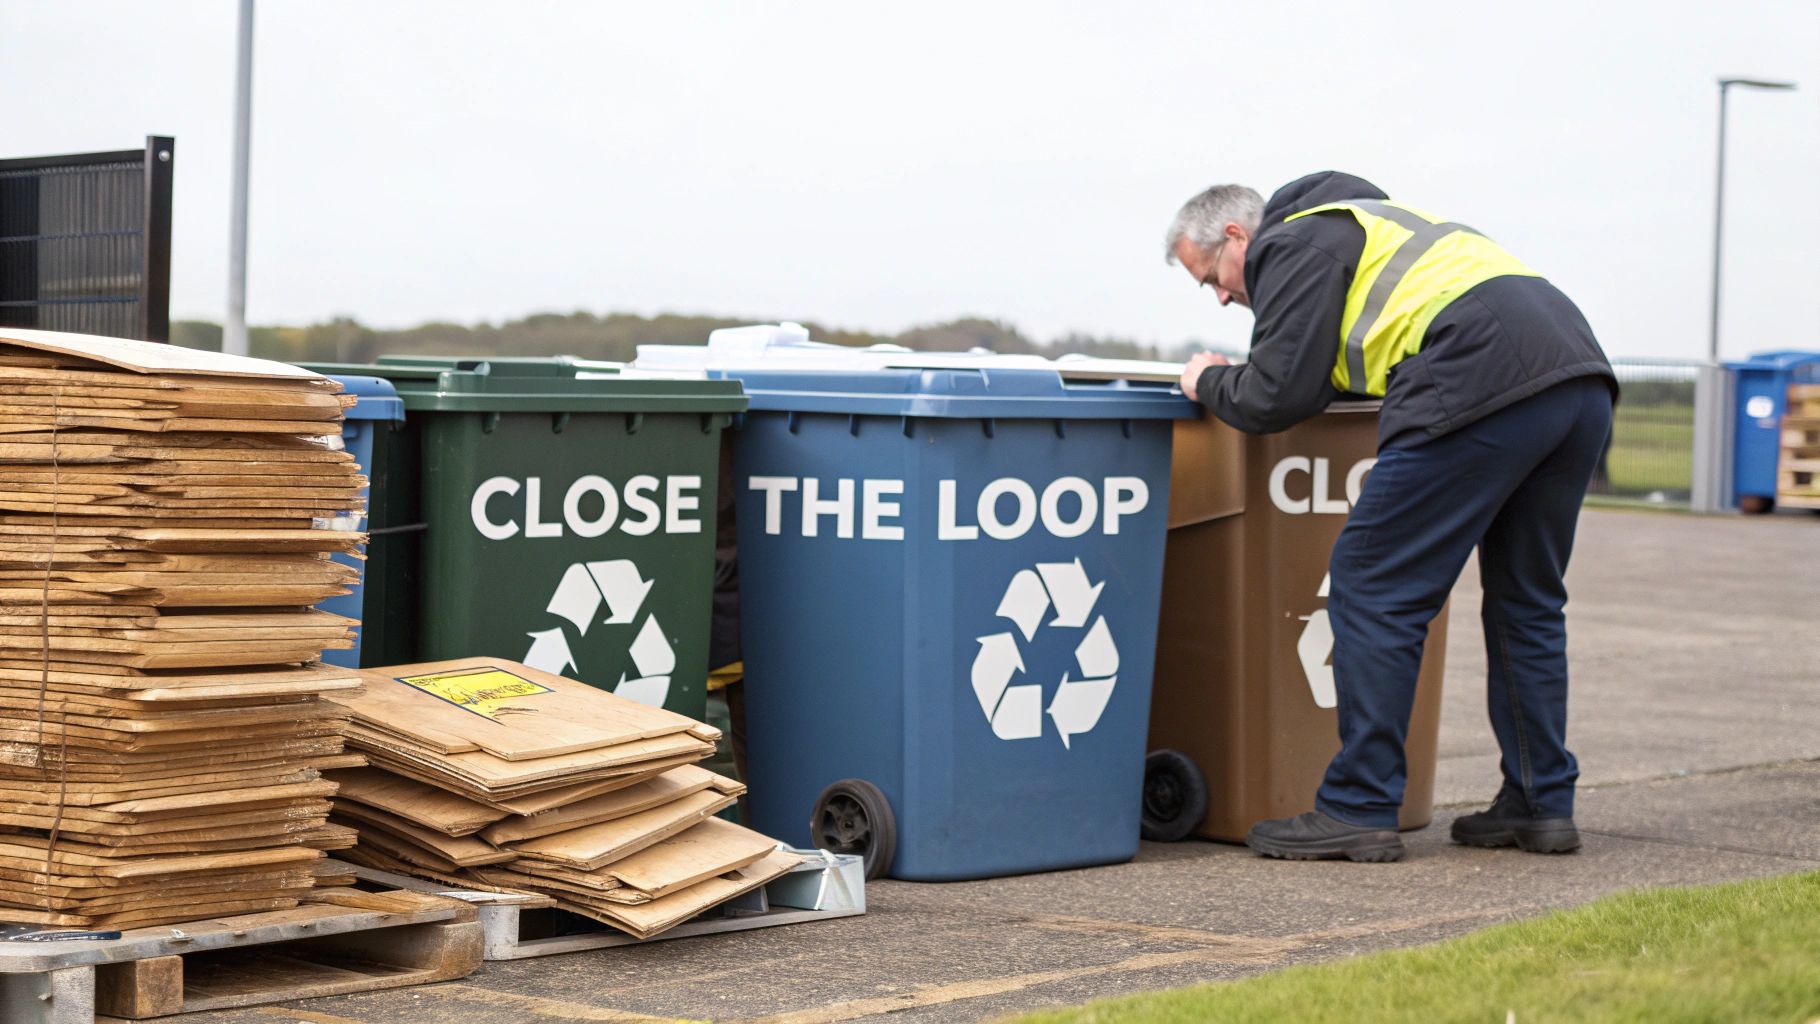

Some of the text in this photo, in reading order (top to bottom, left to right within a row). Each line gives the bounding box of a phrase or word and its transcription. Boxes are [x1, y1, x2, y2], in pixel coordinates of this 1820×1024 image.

[470, 474, 702, 541] CLOSE
[748, 475, 1150, 541] THE LOOP
